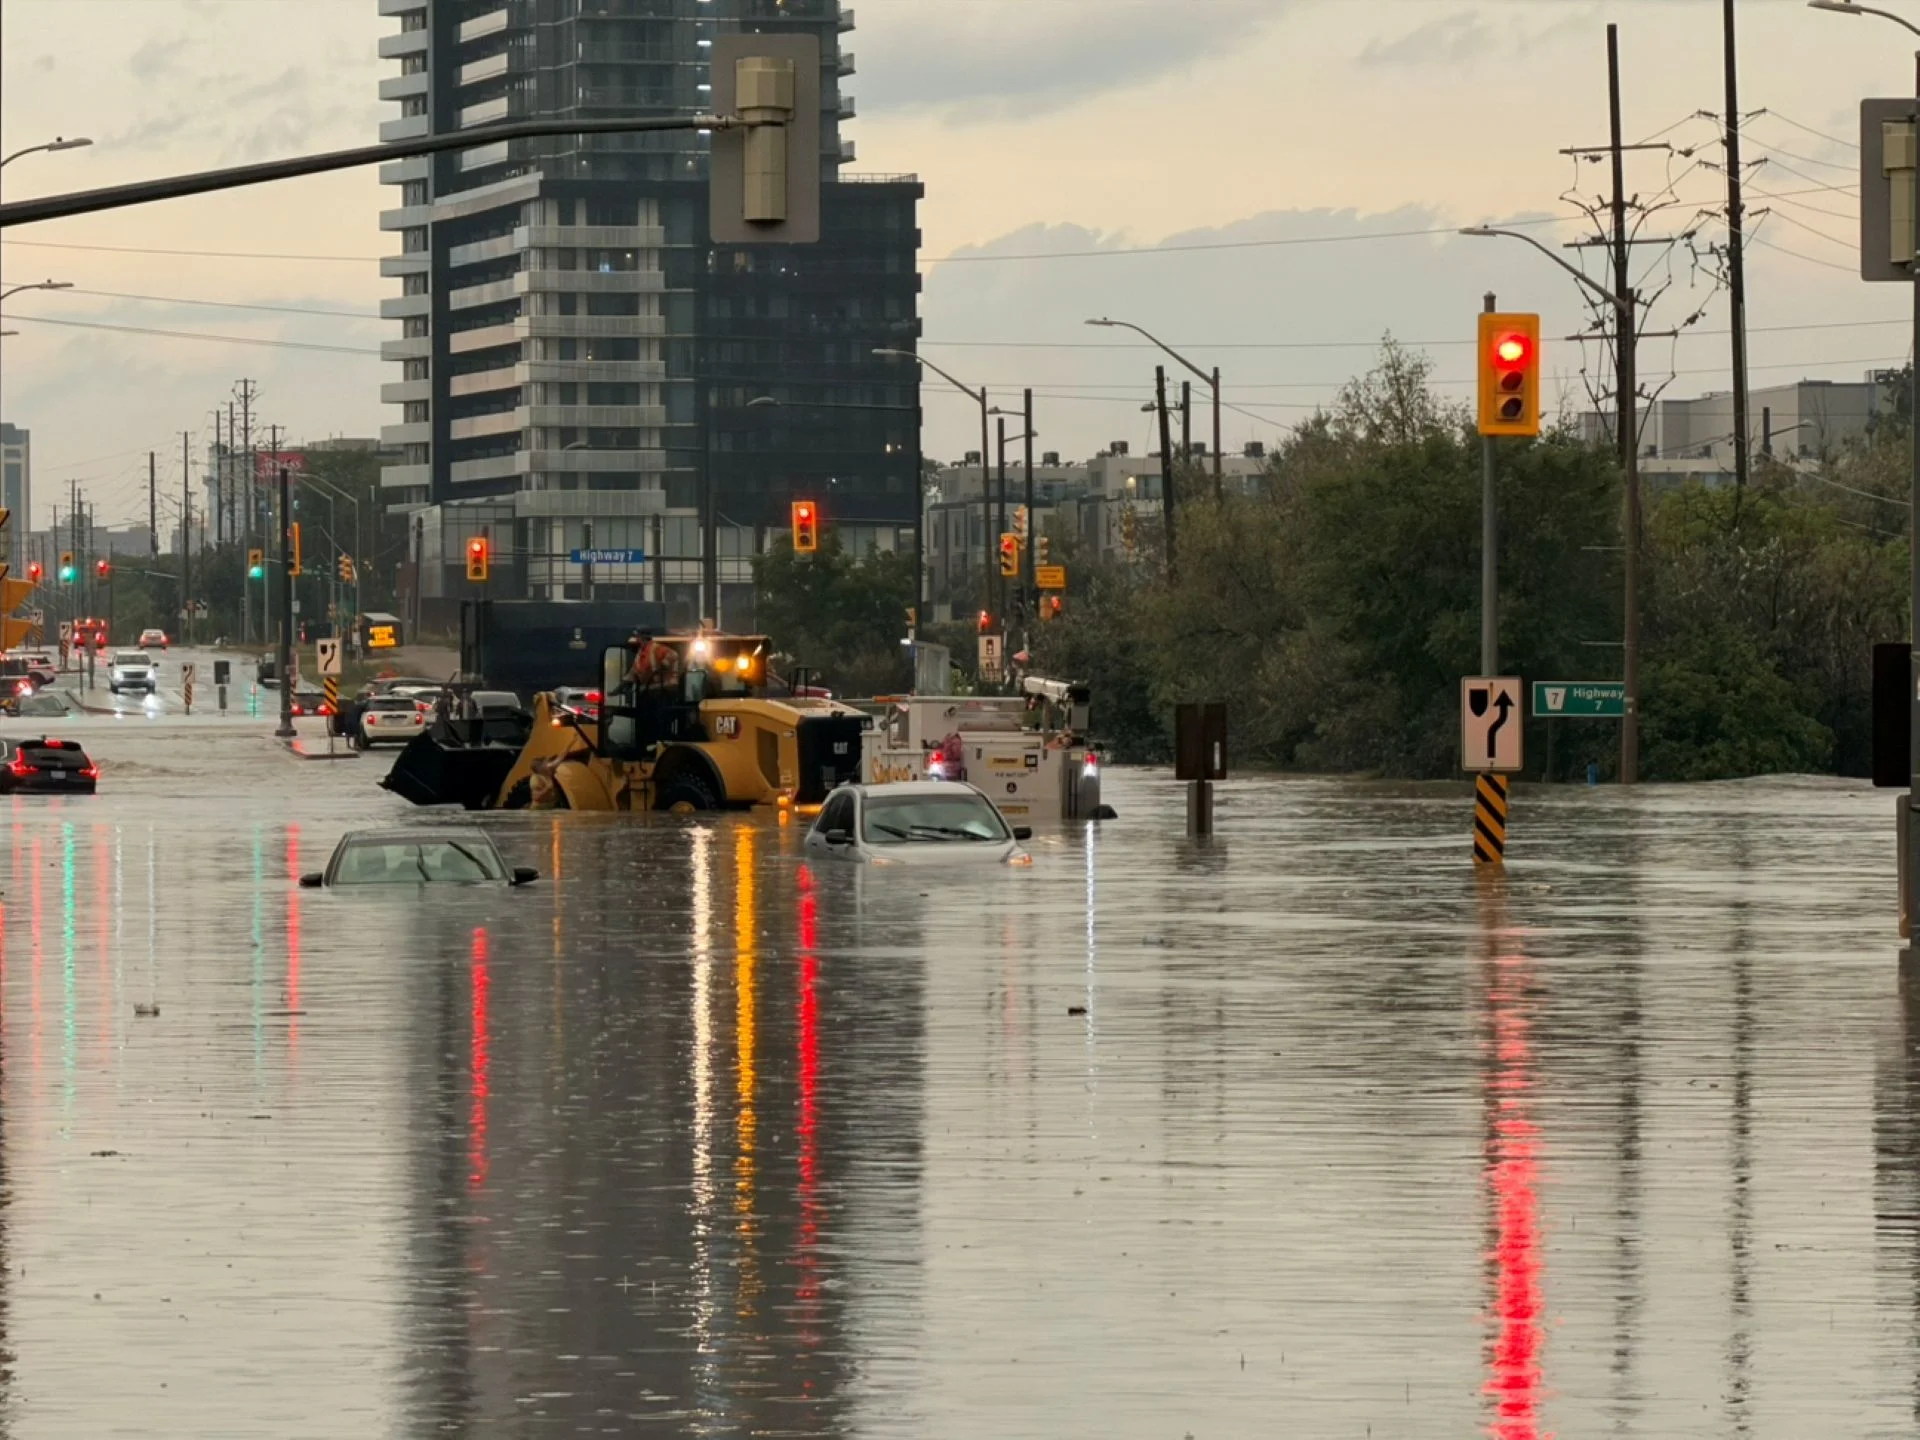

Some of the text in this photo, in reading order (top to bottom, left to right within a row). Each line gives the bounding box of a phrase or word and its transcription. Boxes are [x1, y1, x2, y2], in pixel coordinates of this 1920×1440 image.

[580, 550, 625, 563] Highway
[1551, 692, 1559, 706] 7
[1572, 688, 1624, 700] Highway
[1595, 700, 1603, 711] 7
[716, 716, 736, 734] CAT
[833, 742, 849, 755] CAT
